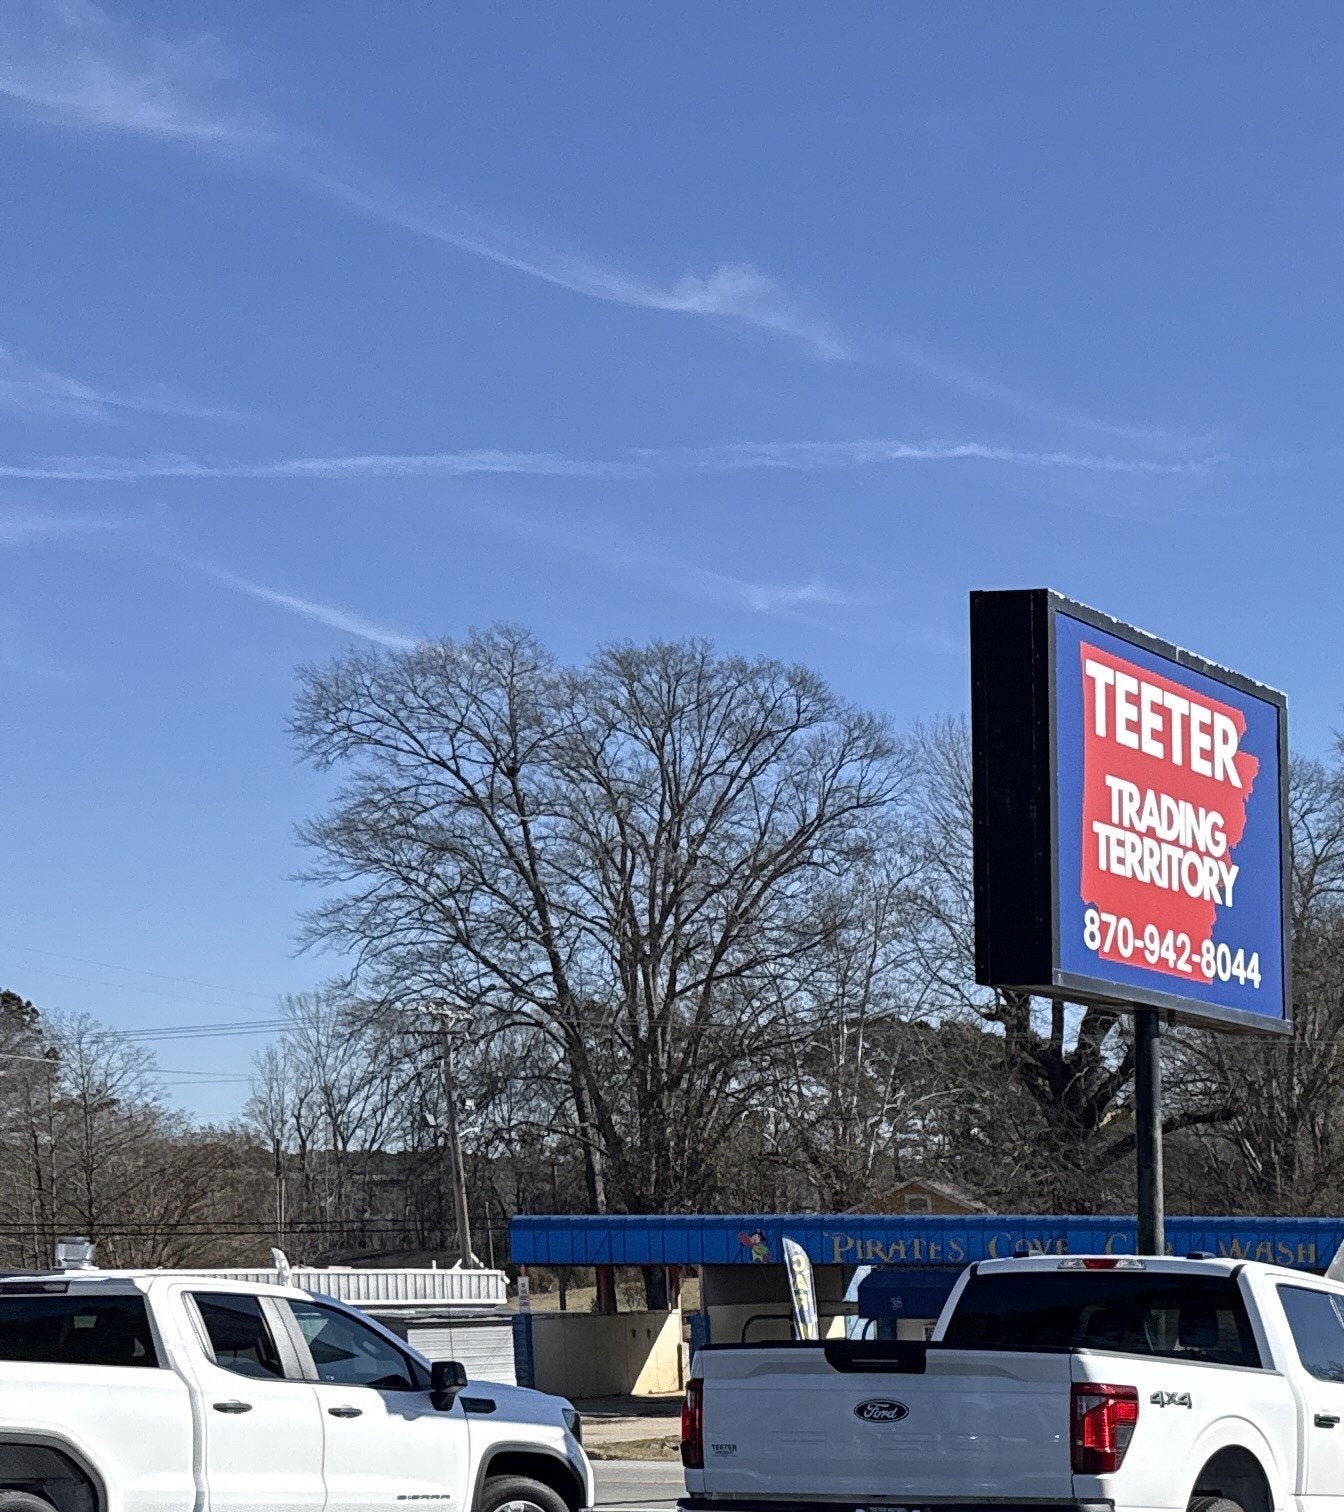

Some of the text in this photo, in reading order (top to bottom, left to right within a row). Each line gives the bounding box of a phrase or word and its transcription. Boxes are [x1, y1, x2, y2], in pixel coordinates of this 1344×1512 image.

[1085, 659, 1242, 788] TEETER
[1106, 774, 1228, 857] TRADING
[1092, 821, 1240, 908] TERRITORY
[1083, 908, 1262, 989] 870-942-8044
[863, 1402, 899, 1418] Ford
